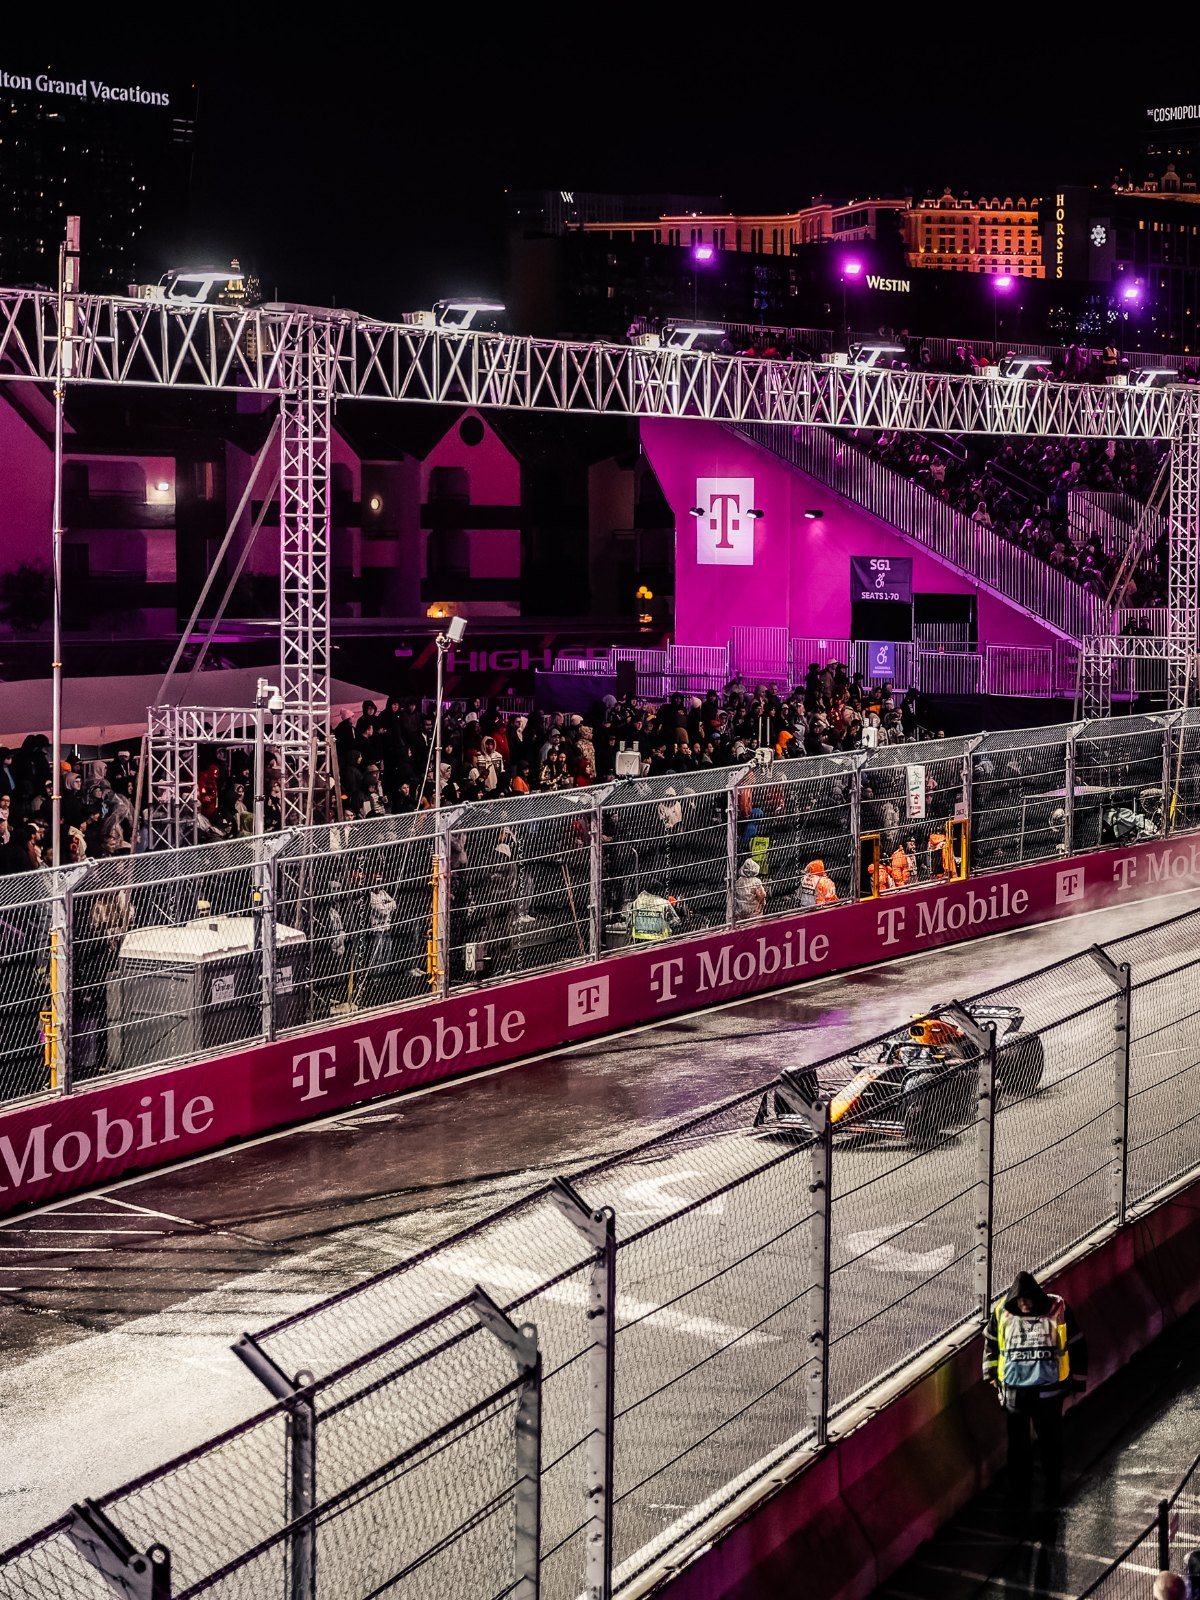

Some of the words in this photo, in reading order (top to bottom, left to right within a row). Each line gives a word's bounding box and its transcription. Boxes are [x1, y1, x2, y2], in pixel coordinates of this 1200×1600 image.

[35, 74, 87, 97] Grand
[90, 80, 170, 107] Vacations
[1056, 194, 1065, 279] HORSES
[865, 274, 910, 293] WESTIN
[709, 494, 740, 549] T
[869, 559, 891, 571] SG1
[861, 591, 884, 600] SEATS
[884, 592, 900, 601] 1-70
[446, 649, 551, 673] HIGH
[1062, 873, 1079, 896] T
[915, 883, 1029, 938] Mobile
[696, 928, 830, 993] Mobile
[577, 985, 600, 1016] T
[353, 1003, 526, 1087] Mobile
[0, 1089, 215, 1192] Mobile
